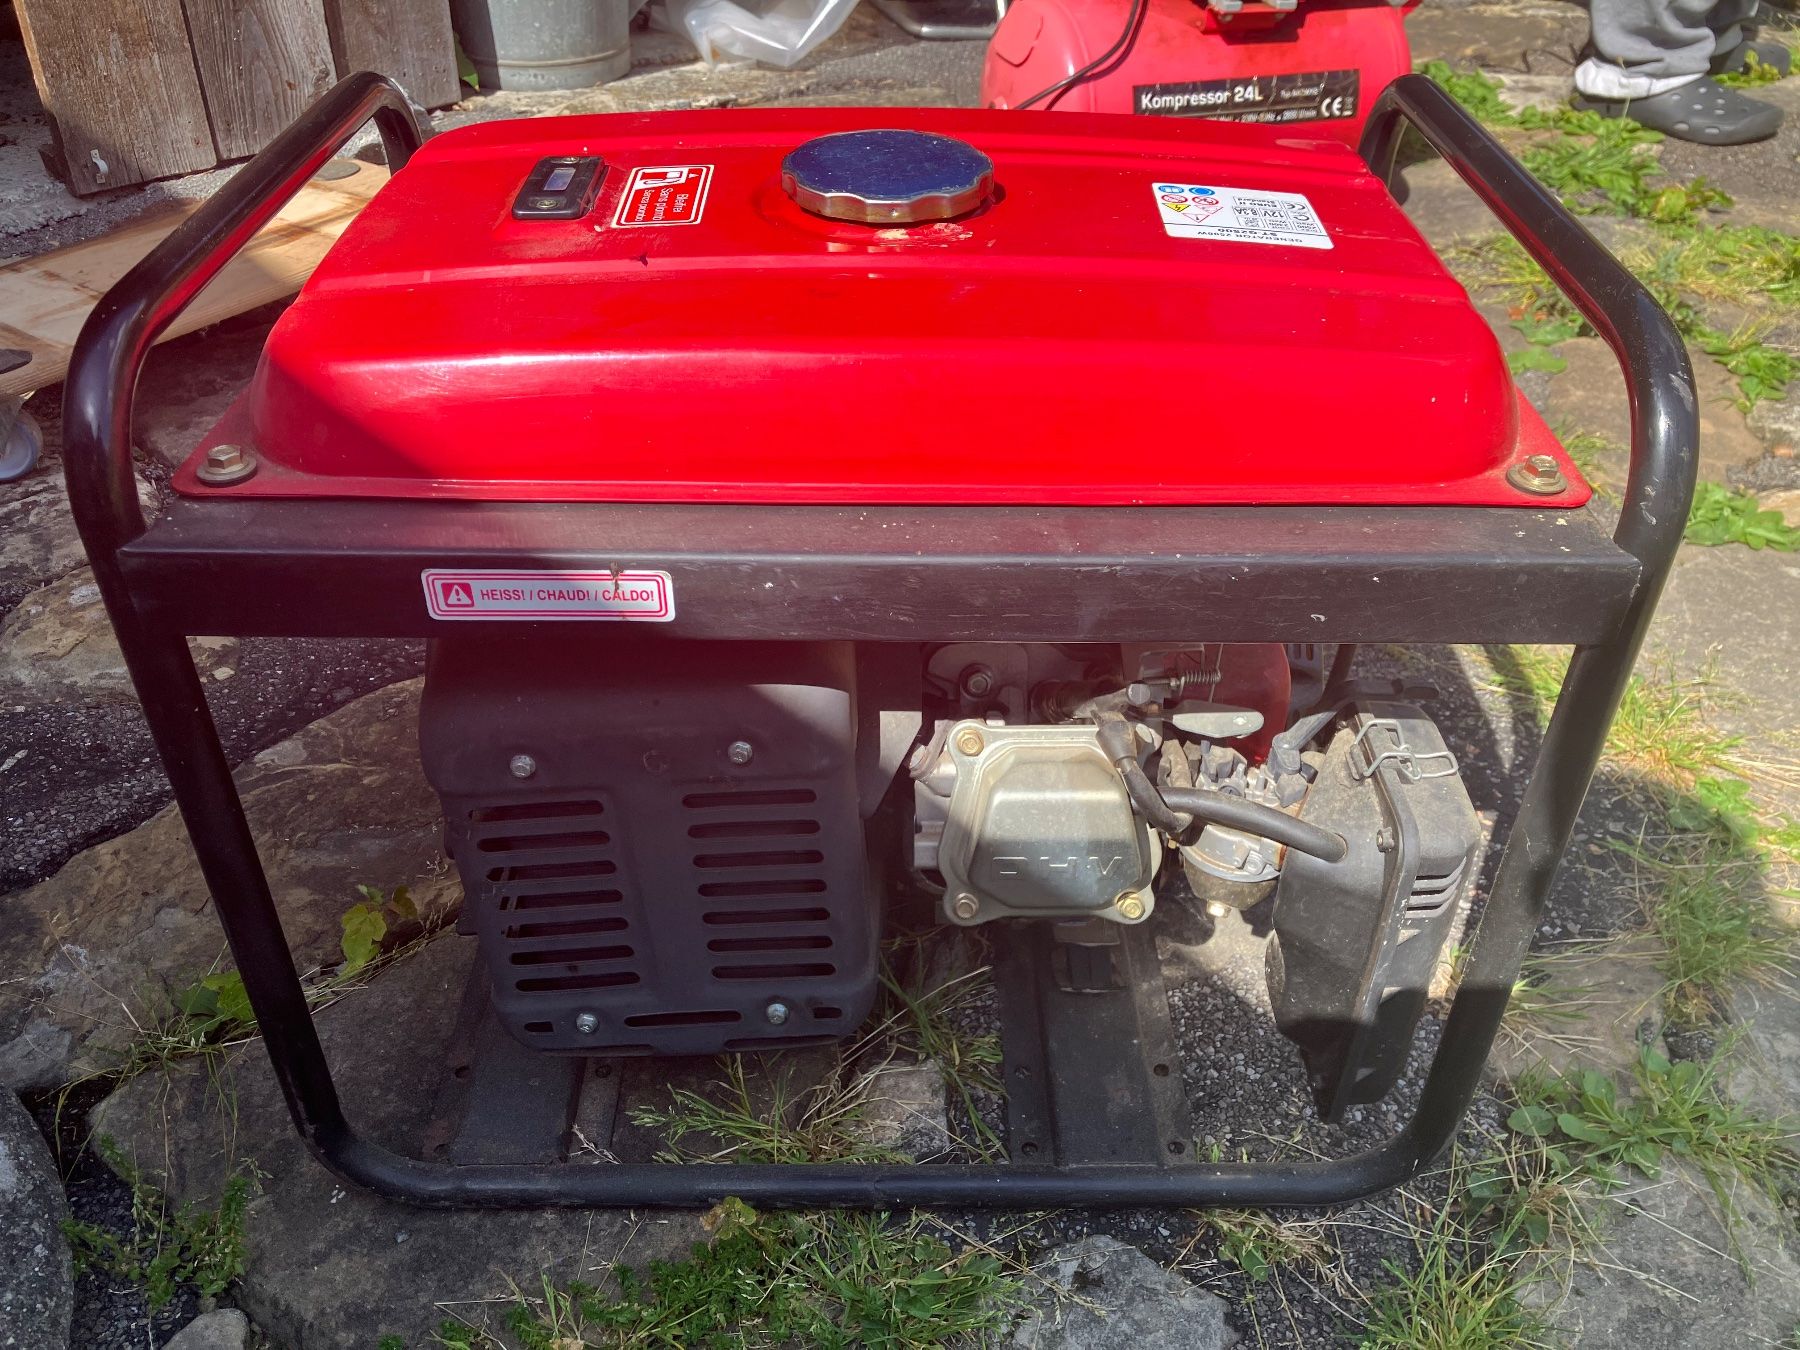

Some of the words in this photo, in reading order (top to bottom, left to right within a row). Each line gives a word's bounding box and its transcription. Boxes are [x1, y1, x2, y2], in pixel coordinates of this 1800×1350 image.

[1141, 91, 1231, 110] Kompressor
[1234, 84, 1264, 102] 24L
[1321, 96, 1342, 117] CE
[658, 187, 674, 202] Sans
[673, 193, 689, 213] Bleifrei
[652, 203, 668, 221] plomb
[1233, 207, 1258, 216] 8.3A
[1264, 210, 1285, 218] 12V
[1236, 234, 1303, 242] GENERATOR
[480, 589, 526, 601] HEISS!
[529, 589, 534, 601] /
[537, 589, 591, 601] CHAUD!
[594, 589, 599, 602] /
[602, 589, 655, 602] CALDO!
